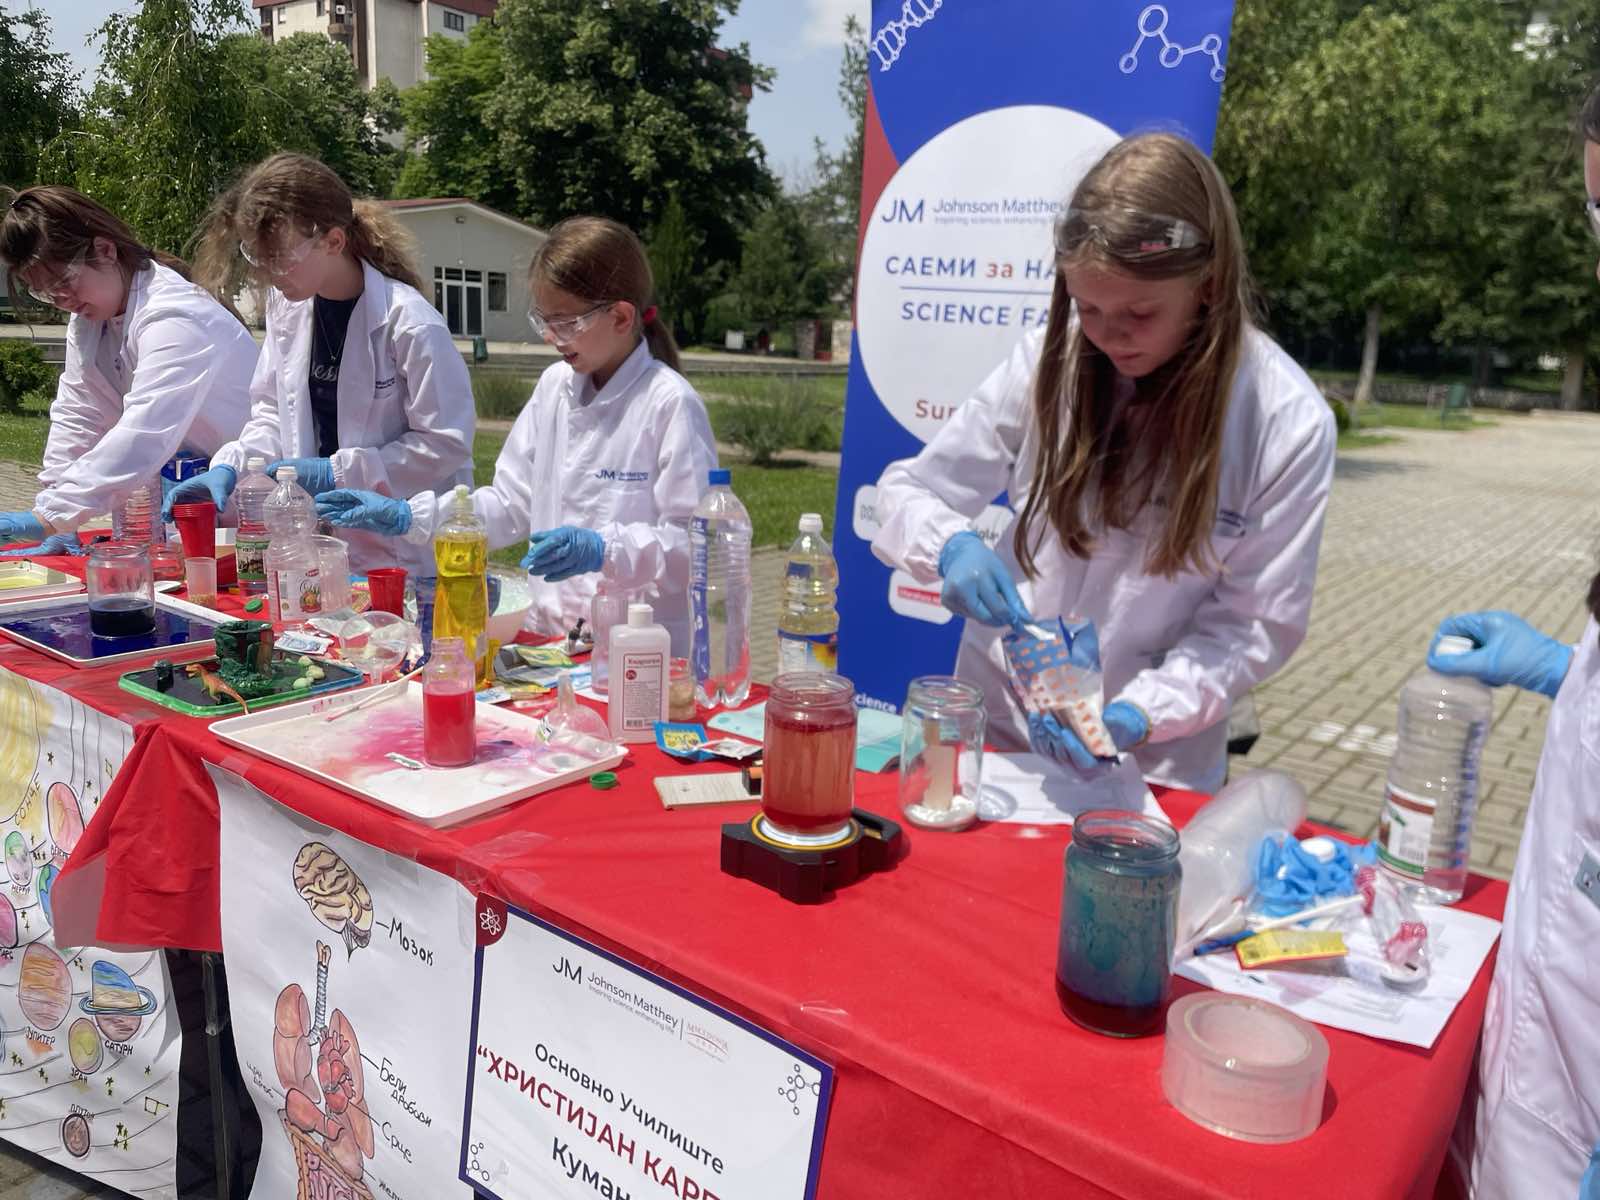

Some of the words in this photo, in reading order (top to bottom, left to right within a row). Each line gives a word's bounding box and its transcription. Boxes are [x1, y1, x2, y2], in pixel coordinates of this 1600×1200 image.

[882, 199, 924, 223] JM
[933, 199, 1000, 214] Johnson
[885, 256, 976, 279] САЕМИ
[985, 263, 1013, 279] за
[1025, 259, 1057, 280] НА
[901, 302, 1012, 326] SCIENCE
[1021, 307, 1051, 327] FA
[853, 693, 897, 714] cience
[389, 916, 434, 967] Мозок
[552, 956, 583, 985] JM
[587, 972, 631, 1003] Johnson
[633, 994, 679, 1028] Matthey
[104, 1040, 134, 1055] САТУРН
[380, 1057, 407, 1095] Бели
[535, 1043, 614, 1103] Основно
[620, 1093, 725, 1174] Училиште
[381, 1121, 412, 1164] Срце
[552, 1137, 631, 1200] Куман
